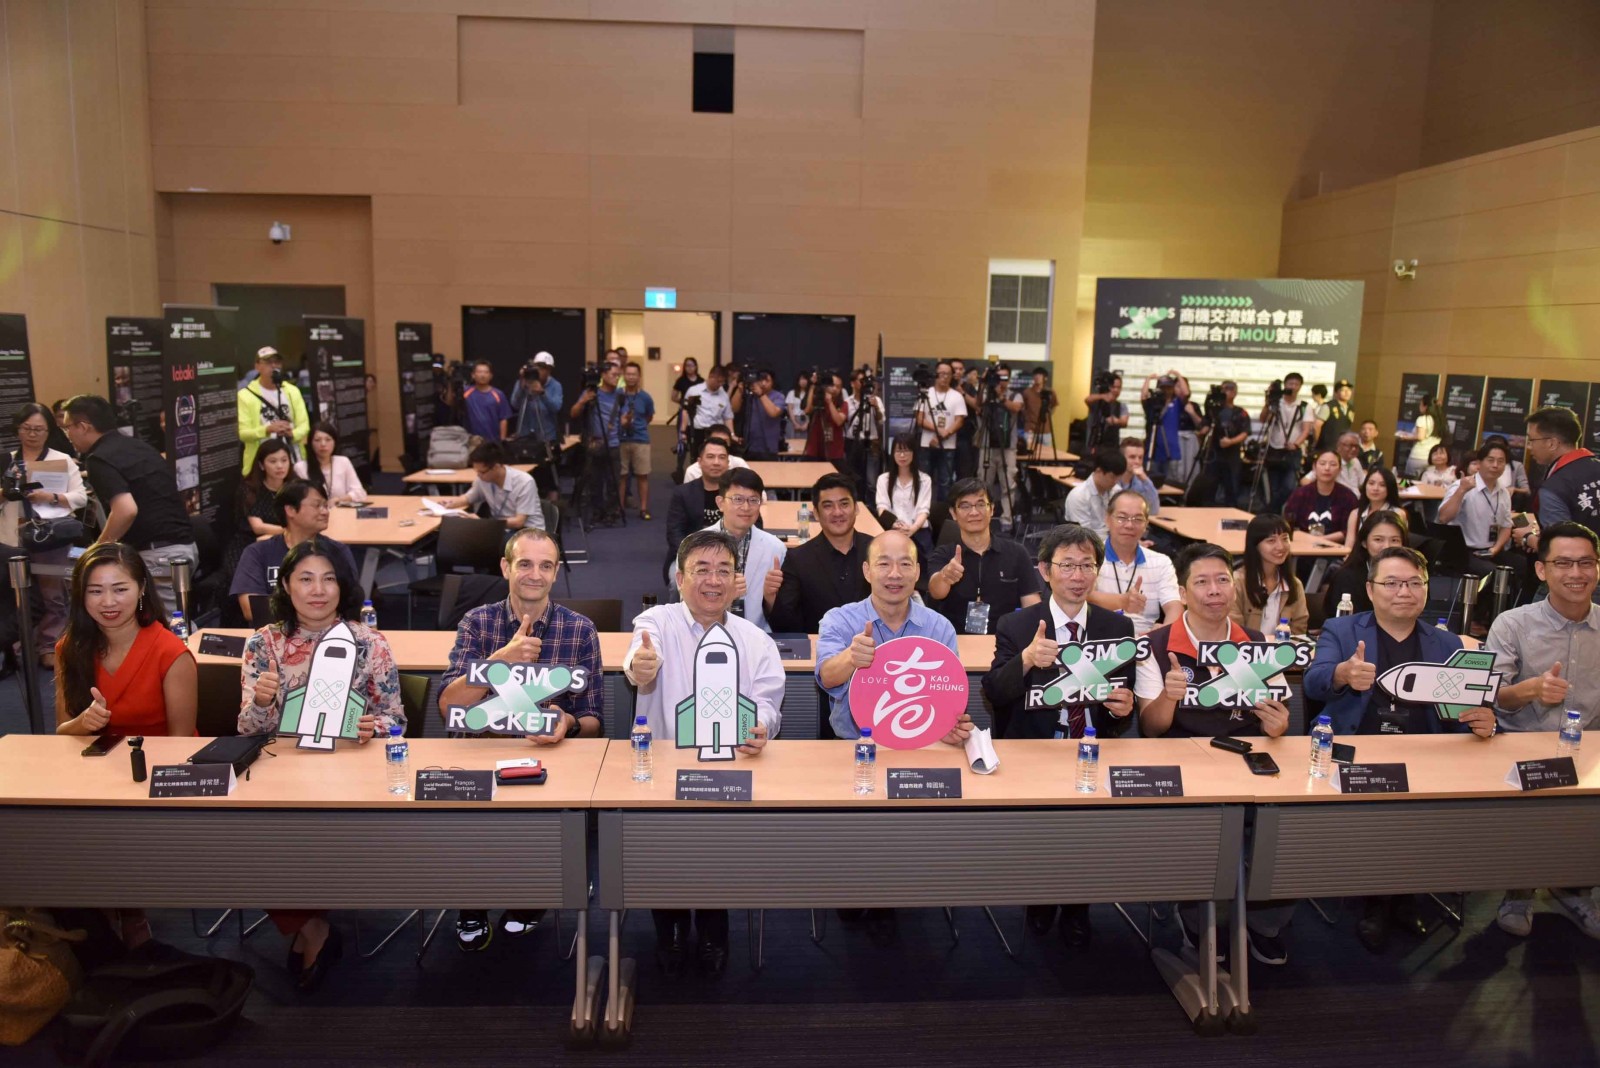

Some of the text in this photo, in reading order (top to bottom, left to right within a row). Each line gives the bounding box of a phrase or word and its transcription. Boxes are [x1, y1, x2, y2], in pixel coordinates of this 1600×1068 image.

[469, 662, 585, 690] KOSMOS
[861, 676, 889, 685] LOVE
[930, 675, 950, 683] KAO
[929, 683, 965, 692] HSIUNG
[449, 707, 558, 733] ROCKET
[739, 713, 748, 740] KOSMOS
